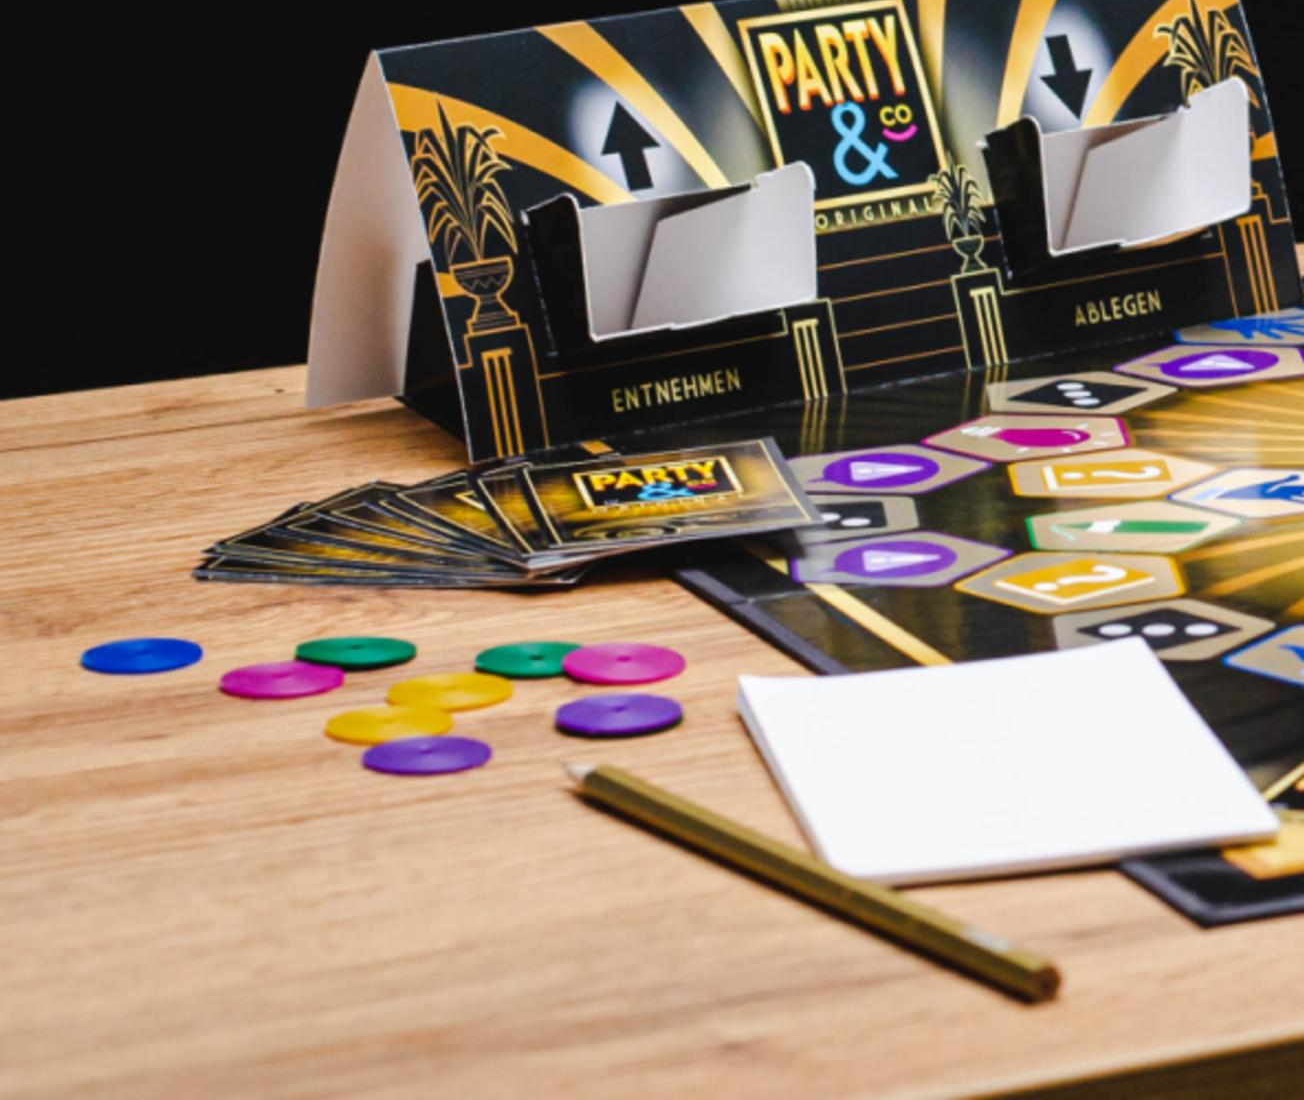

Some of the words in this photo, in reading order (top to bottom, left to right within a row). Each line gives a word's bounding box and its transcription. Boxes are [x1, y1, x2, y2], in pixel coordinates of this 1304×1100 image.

[758, 14, 906, 114] PARTY
[830, 101, 899, 186] &
[879, 104, 913, 127] CO
[816, 197, 934, 230] ORIGINAL
[1074, 289, 1162, 327] ABLEGEN
[611, 367, 741, 413] ENTNEHMEN
[589, 461, 716, 492] PARTY
